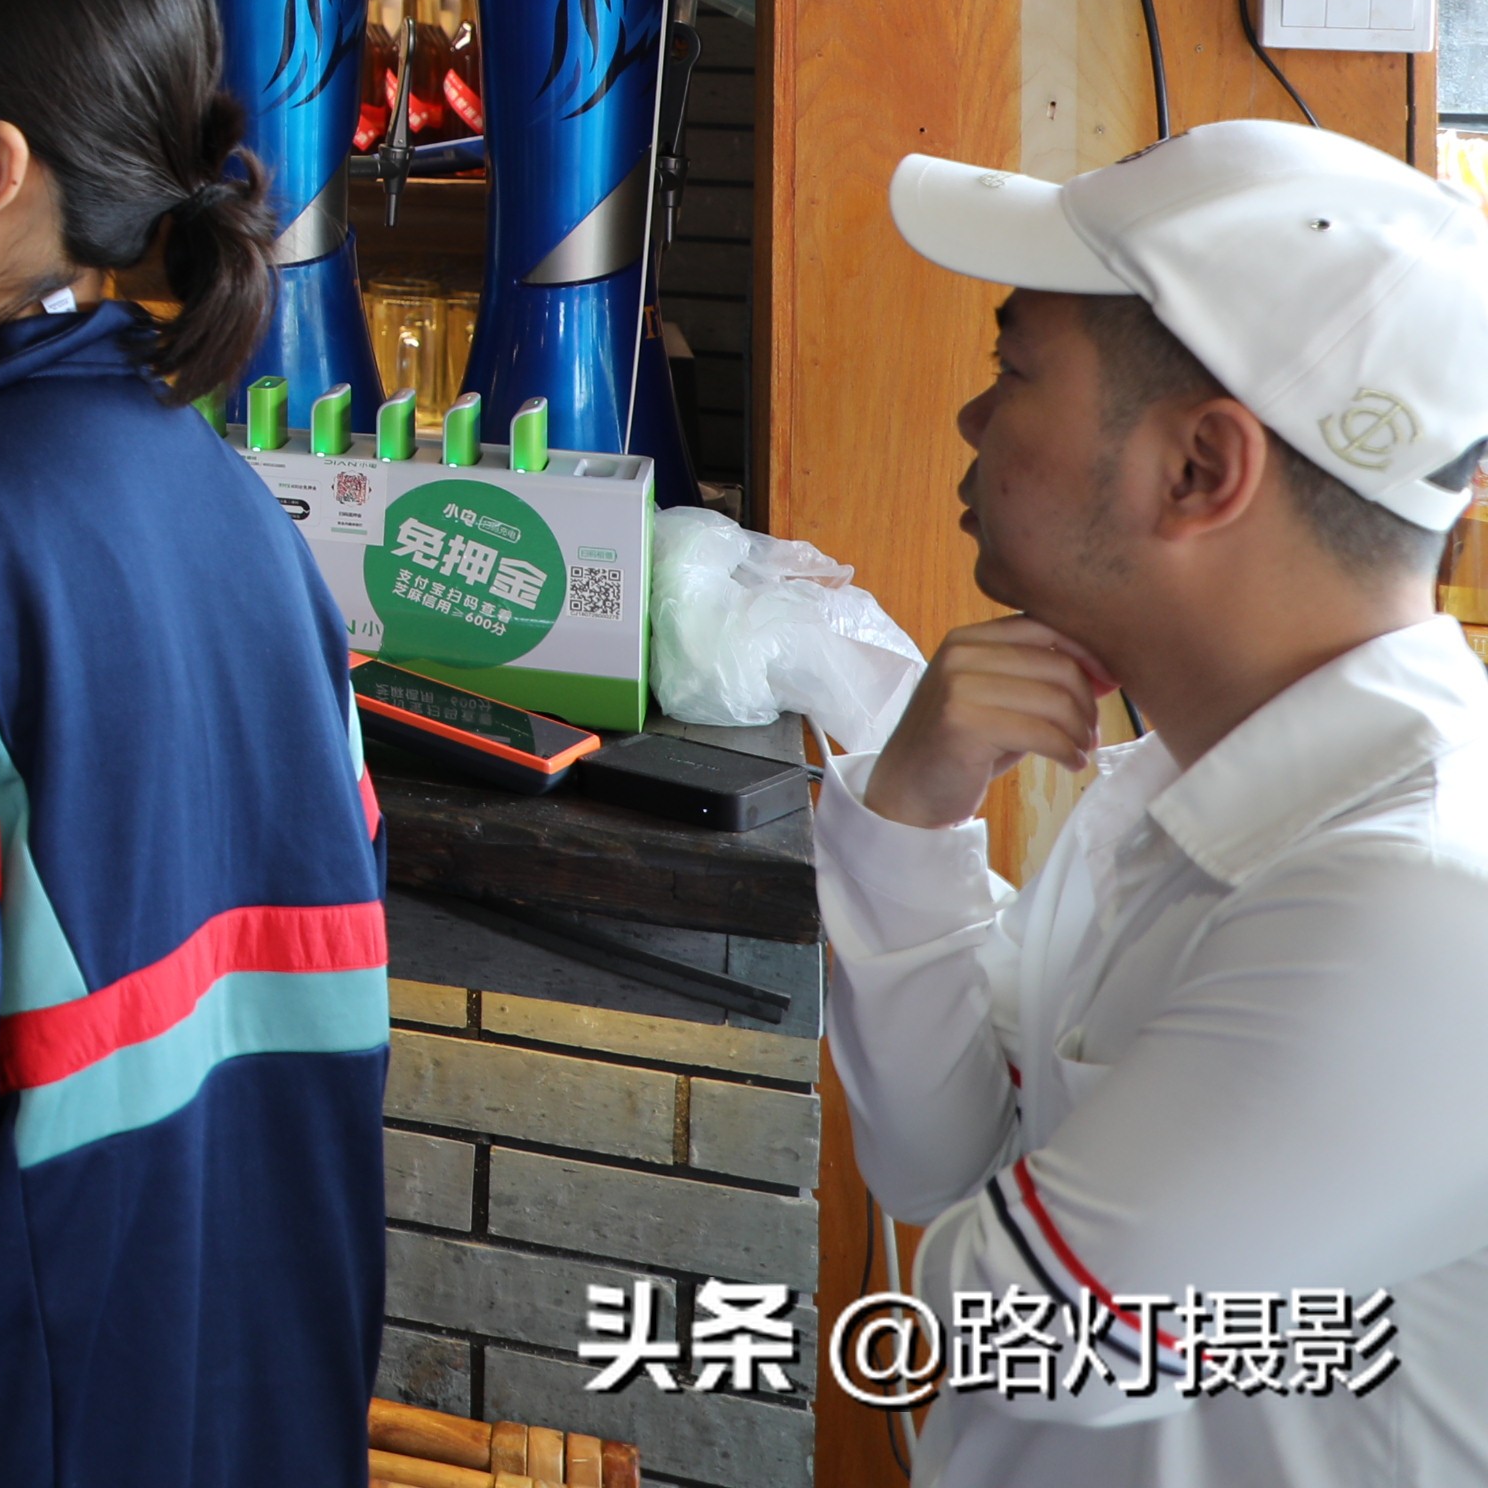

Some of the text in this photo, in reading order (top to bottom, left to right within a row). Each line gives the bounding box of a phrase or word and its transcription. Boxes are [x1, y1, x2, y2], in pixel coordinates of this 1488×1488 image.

[443, 503, 478, 528] 小电
[390, 517, 548, 611] 免押金
[396, 568, 513, 624] 支付宝扫码查看
